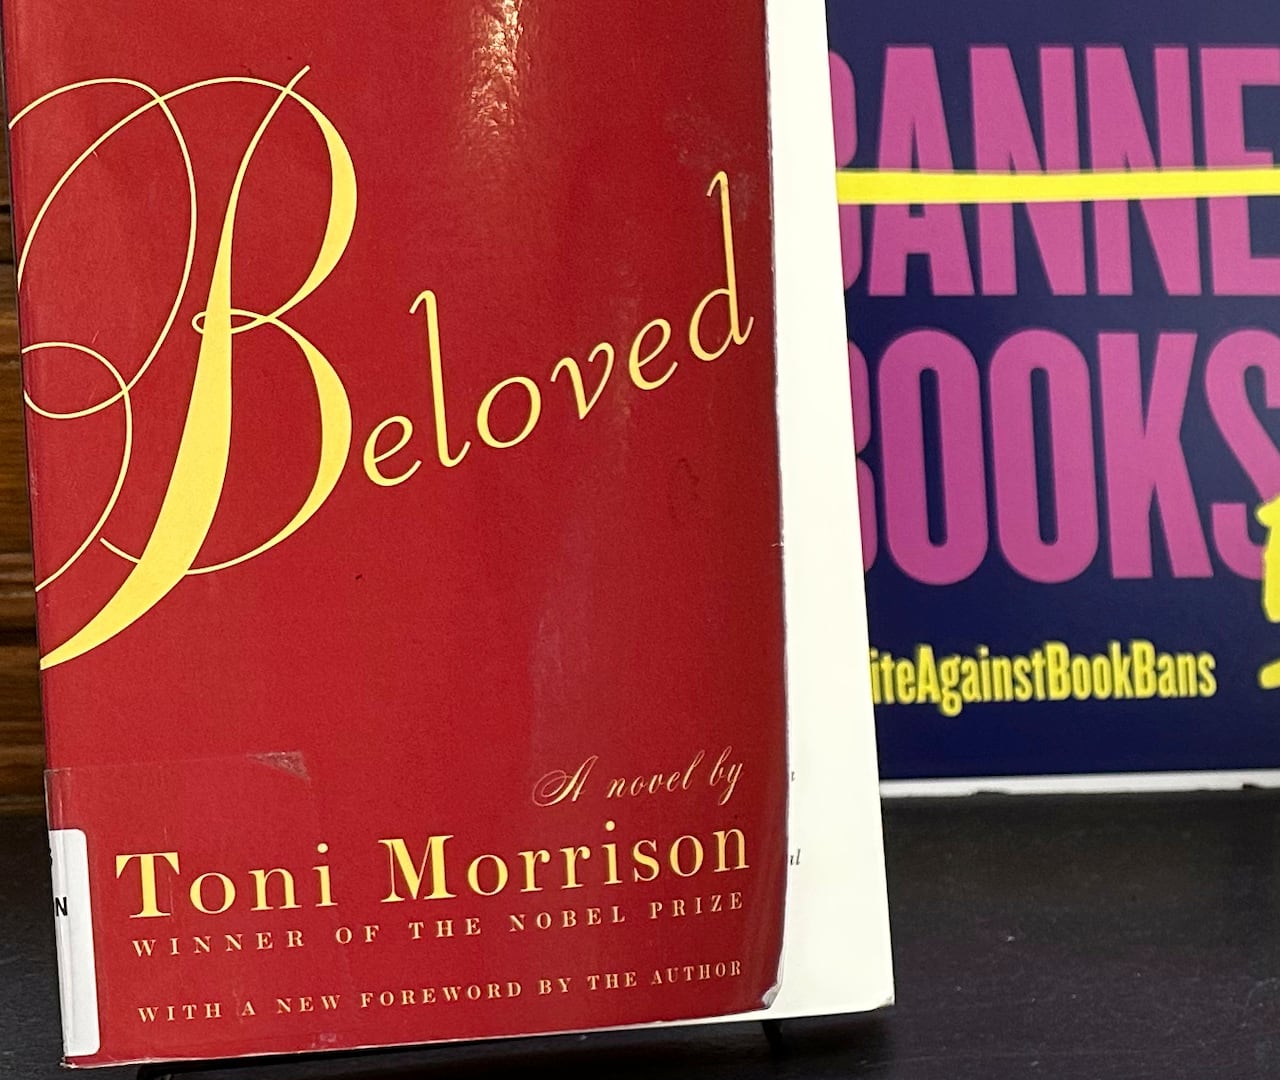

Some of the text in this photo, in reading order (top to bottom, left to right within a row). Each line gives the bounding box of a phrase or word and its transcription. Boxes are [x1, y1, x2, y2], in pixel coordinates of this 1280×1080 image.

[9, 66, 755, 671] Beloved
[870, 640, 1217, 718] iteAgainstBookBans
[533, 744, 745, 807] A novel by
[115, 819, 750, 919] Toni Morrison
[132, 891, 744, 958] WINNER OF THE NOBEL PRIZE
[137, 959, 743, 1023] WITH A NEW FOREWORD BY THE AUTHOR
